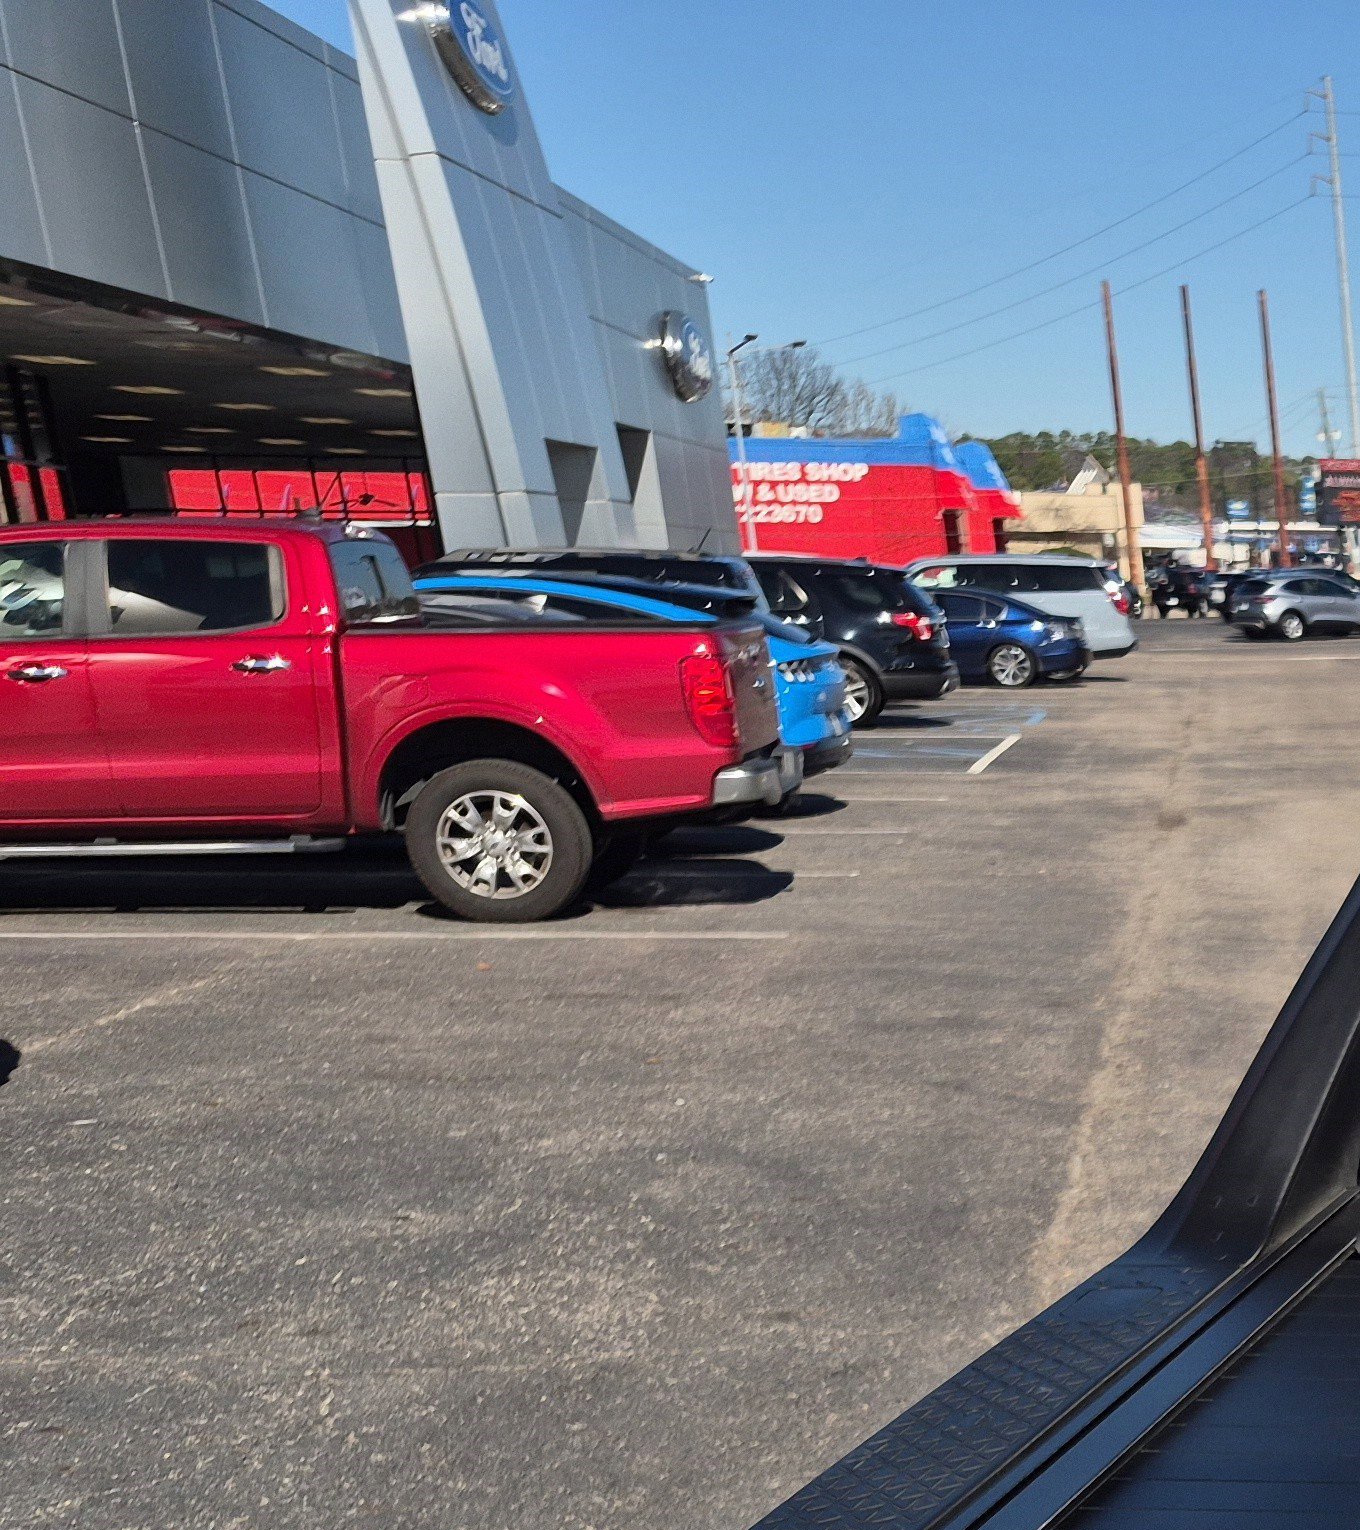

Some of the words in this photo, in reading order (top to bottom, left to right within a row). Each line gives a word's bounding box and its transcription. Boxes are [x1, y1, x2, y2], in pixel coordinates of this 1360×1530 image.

[461, 2, 508, 81] Ford
[803, 462, 870, 482] SHOP
[775, 482, 841, 502] USED
